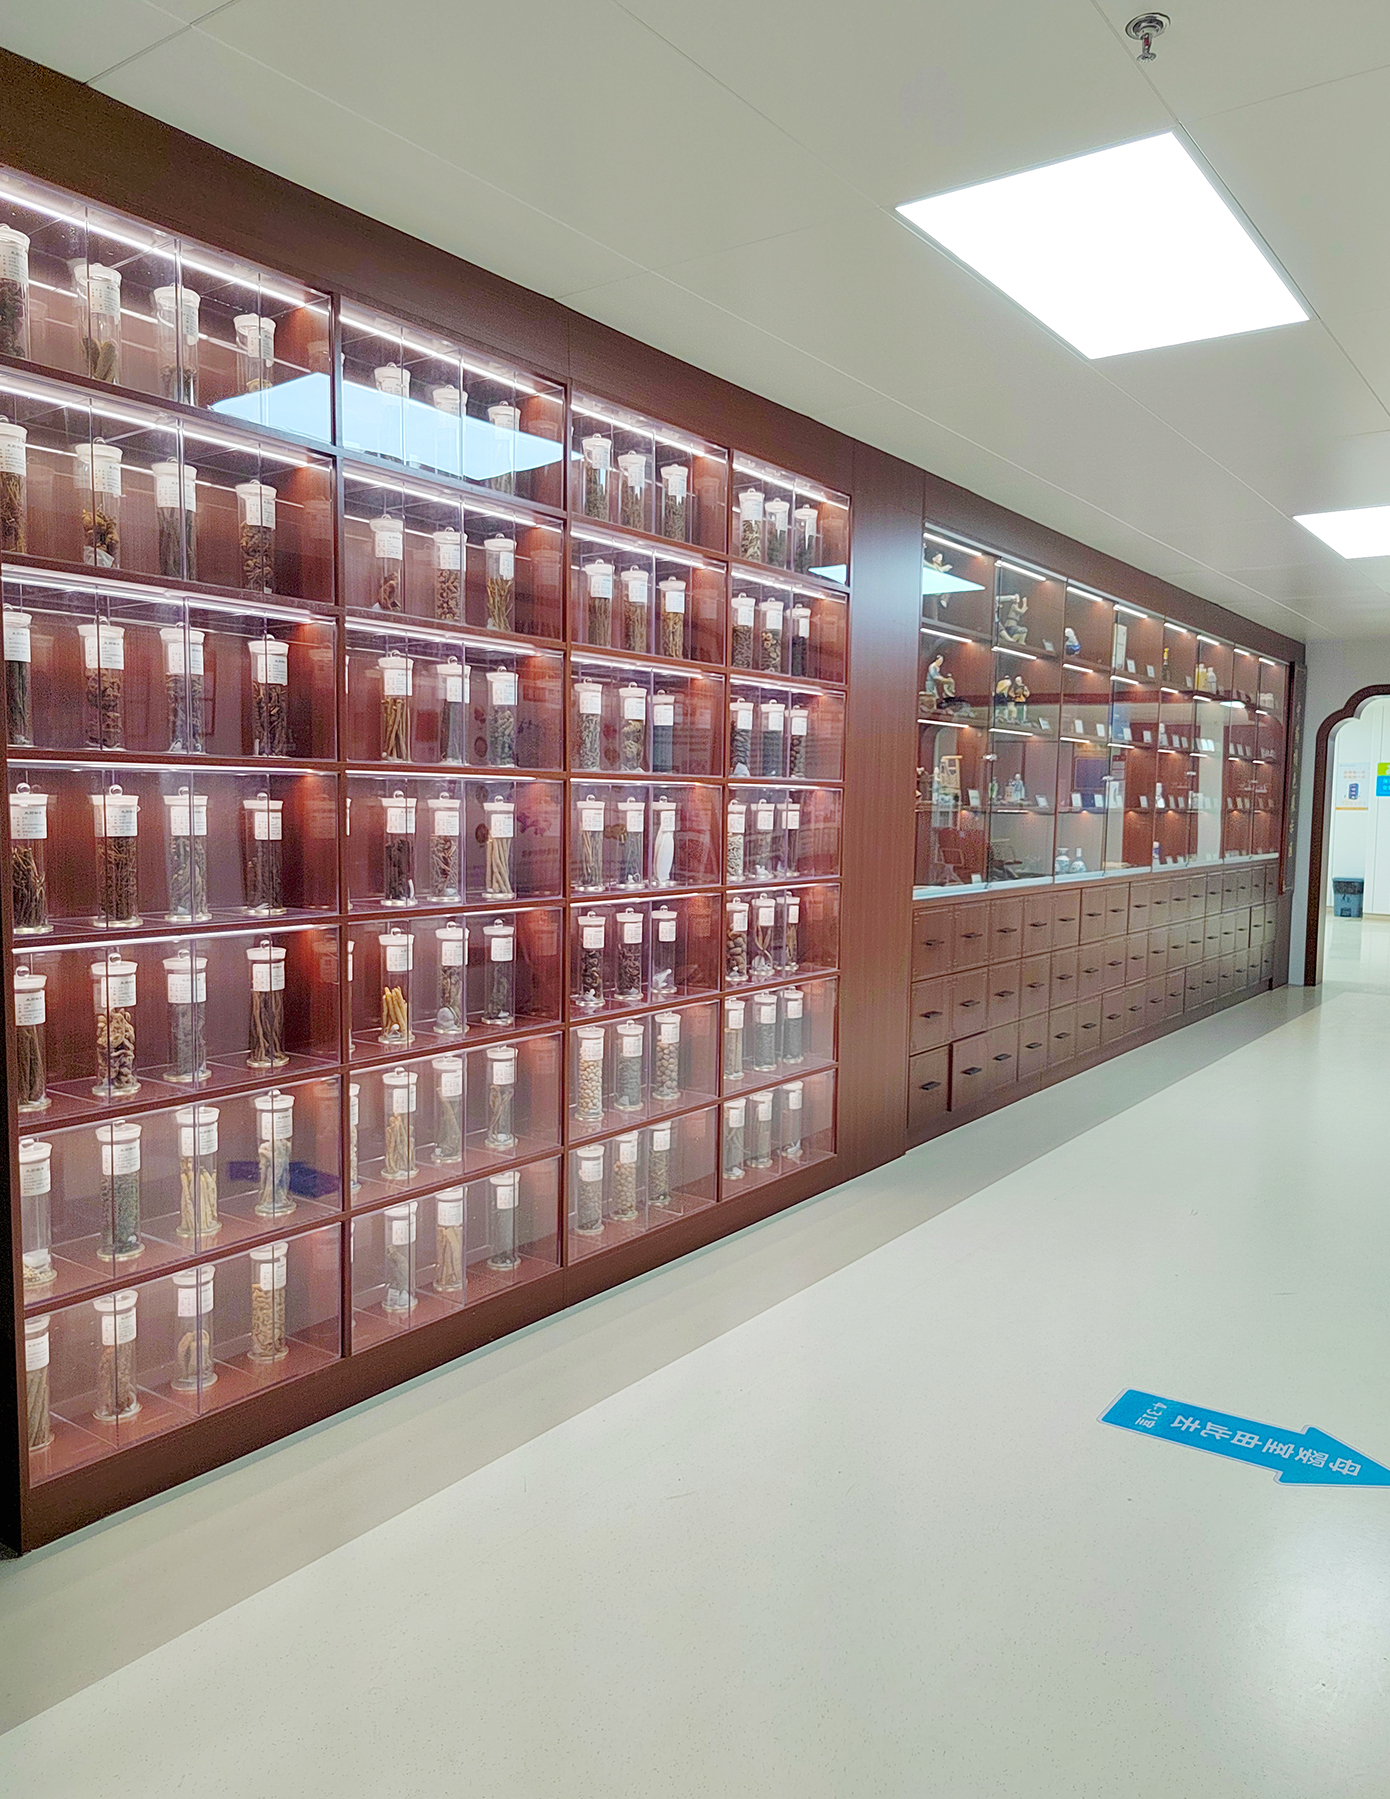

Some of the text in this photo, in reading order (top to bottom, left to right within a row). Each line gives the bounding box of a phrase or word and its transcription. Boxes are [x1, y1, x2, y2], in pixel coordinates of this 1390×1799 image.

[1171, 1415, 1361, 1477] 母婴室由此去
